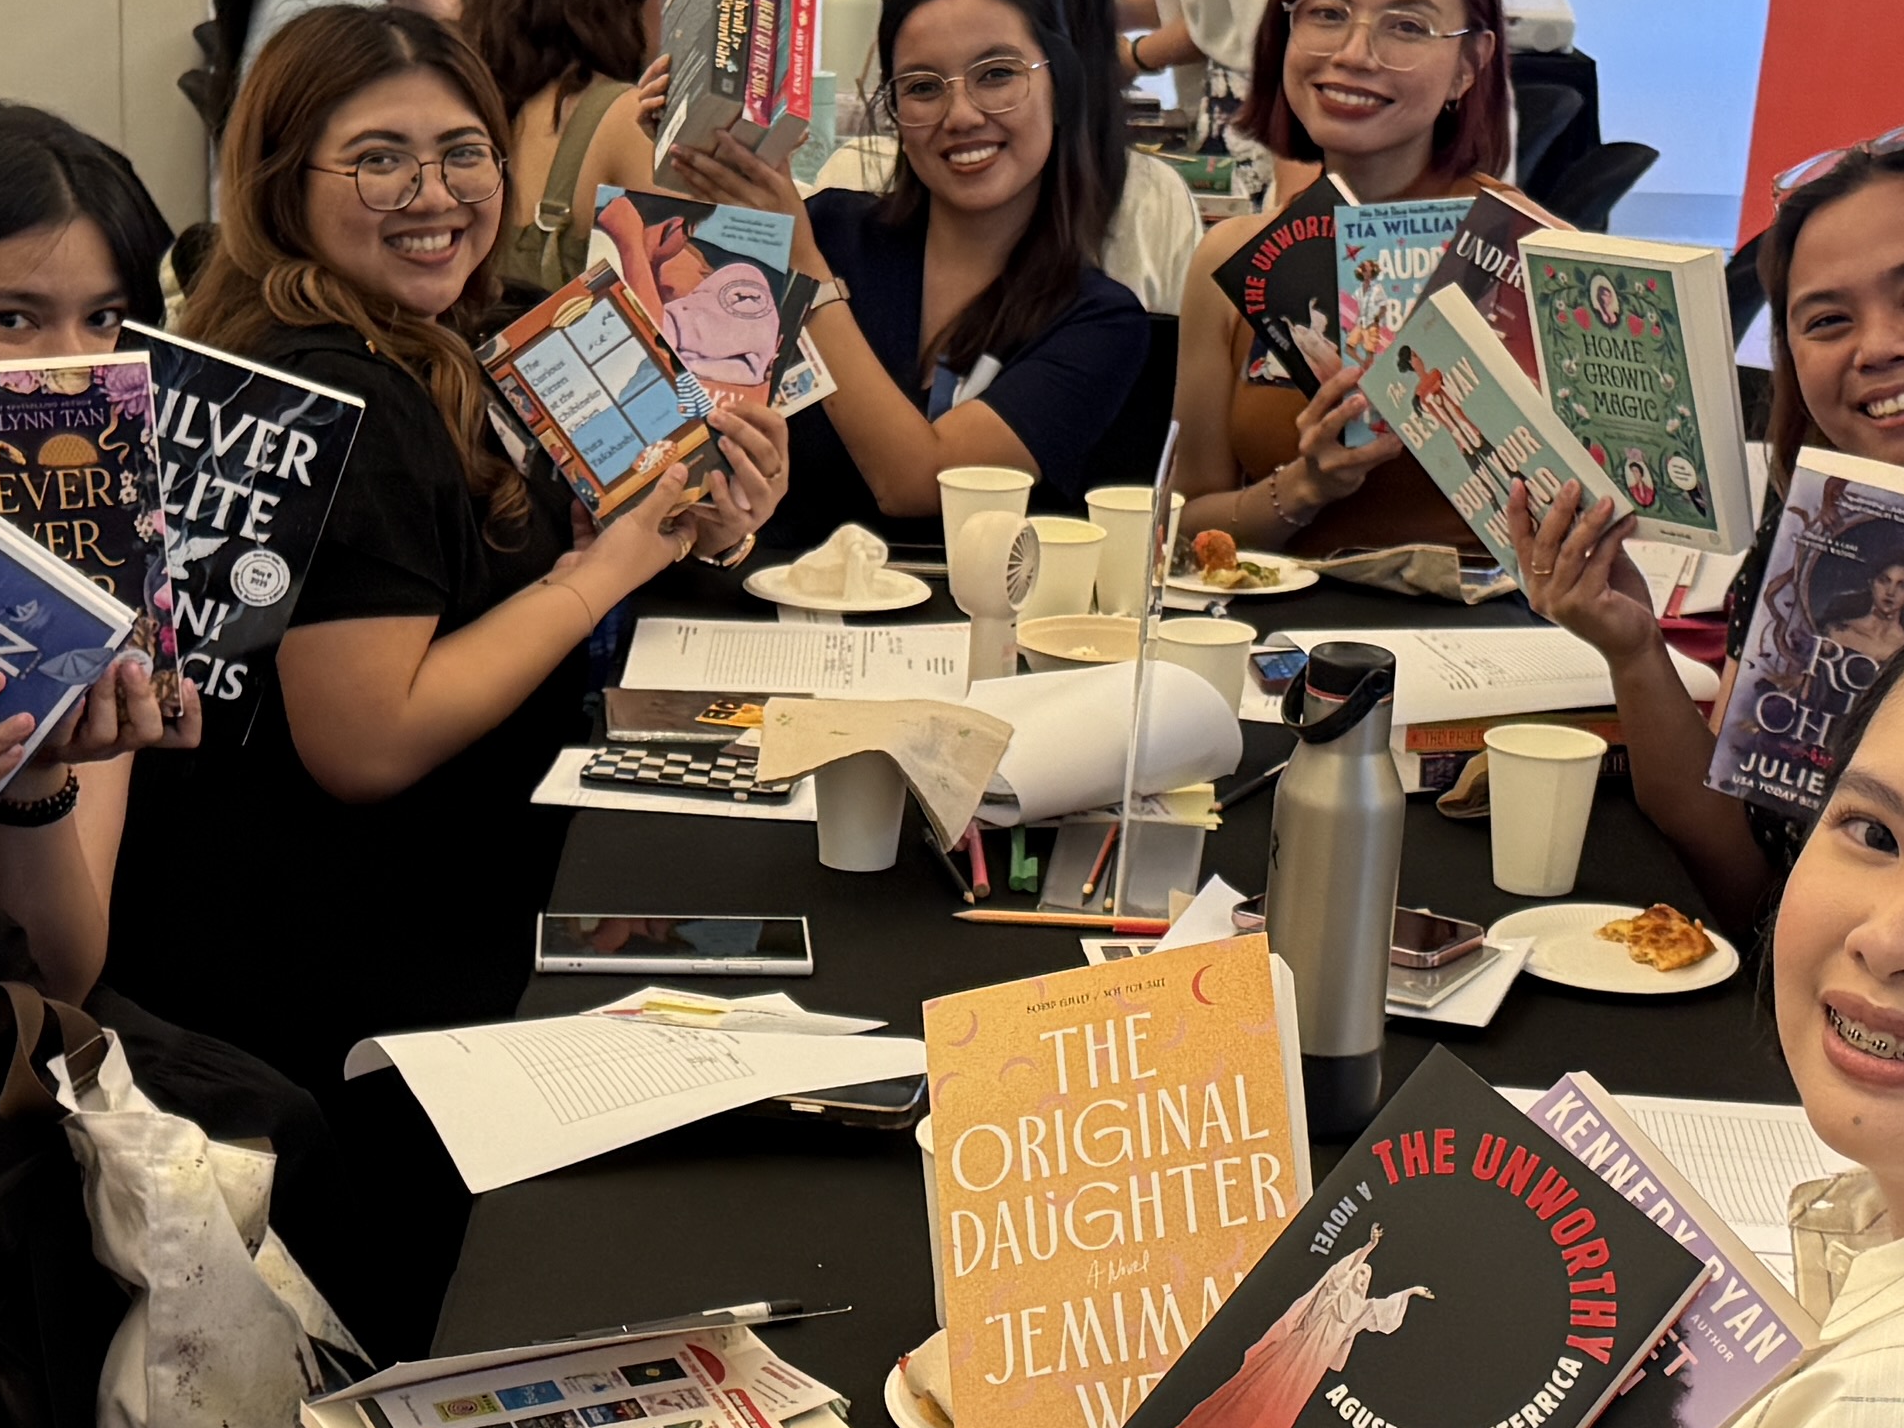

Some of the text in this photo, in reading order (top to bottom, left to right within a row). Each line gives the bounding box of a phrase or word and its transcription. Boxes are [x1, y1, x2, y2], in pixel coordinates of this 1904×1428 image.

[1344, 222, 1377, 239] TIA
[1244, 274, 1267, 315] THE
[522, 359, 541, 375] The
[1581, 333, 1646, 365] HOME
[1439, 357, 1481, 407] WAY
[1583, 364, 1657, 396] GROWN
[59, 407, 107, 428] TAN
[1592, 391, 1660, 422] MAGIC
[153, 382, 318, 487] ILVER
[1451, 425, 1543, 521] BURY YOUR
[162, 462, 281, 544] LITE
[1731, 773, 1756, 789] USA
[1758, 781, 1798, 803] TODAY
[1739, 751, 1827, 797] JULIE
[1040, 1011, 1158, 1095] THE
[951, 1074, 1271, 1194] ORIGINAL
[950, 1151, 1287, 1279] DAUGHTER
[1309, 1180, 1374, 1258] A NOVEL
[1085, 1249, 1152, 1289] A Novel
[1372, 1128, 1619, 1365] THE UNWORTHY
[984, 1272, 1244, 1387] JEMIMA
[1690, 1313, 1736, 1364] AUTHOR
